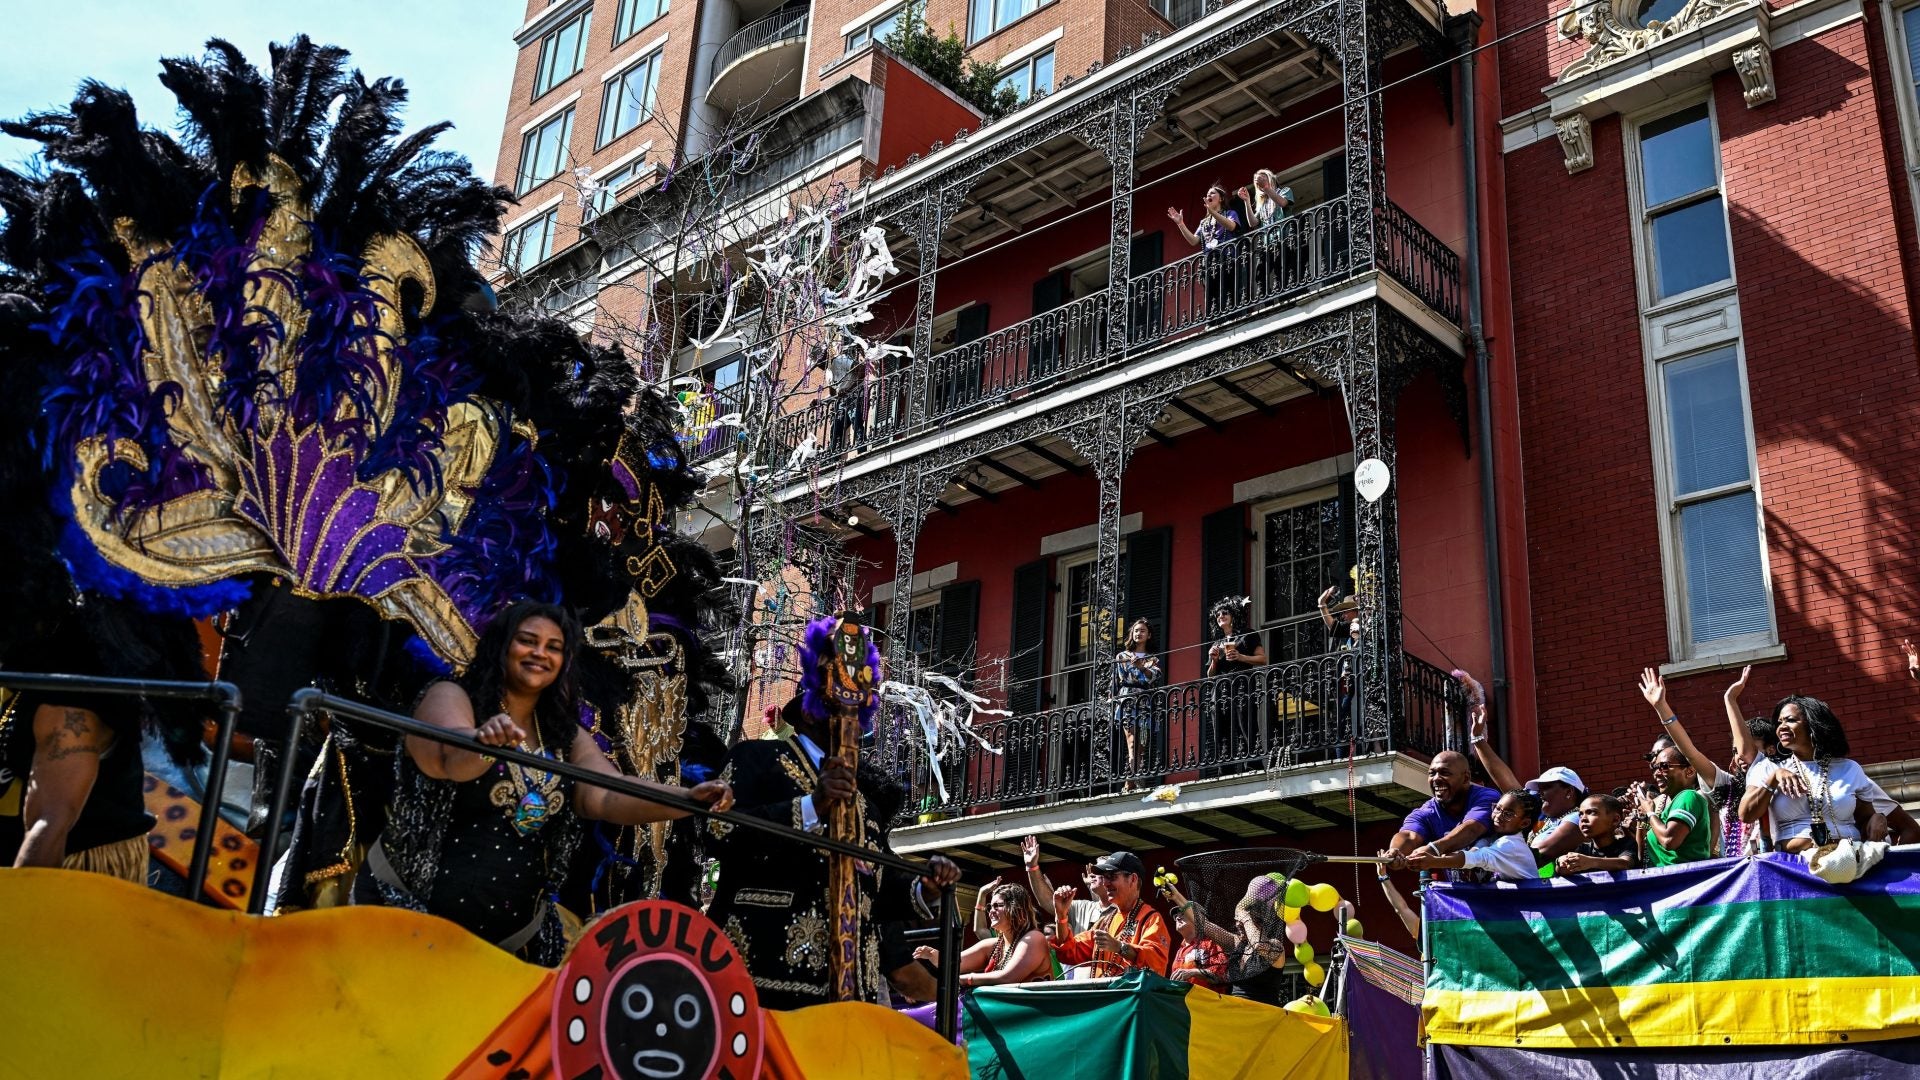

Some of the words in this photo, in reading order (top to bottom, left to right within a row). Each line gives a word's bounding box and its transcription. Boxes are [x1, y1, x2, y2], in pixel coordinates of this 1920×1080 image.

[835, 686, 864, 701] 2023
[595, 908, 733, 973] ZULU
[840, 883, 856, 1001] AMBA
